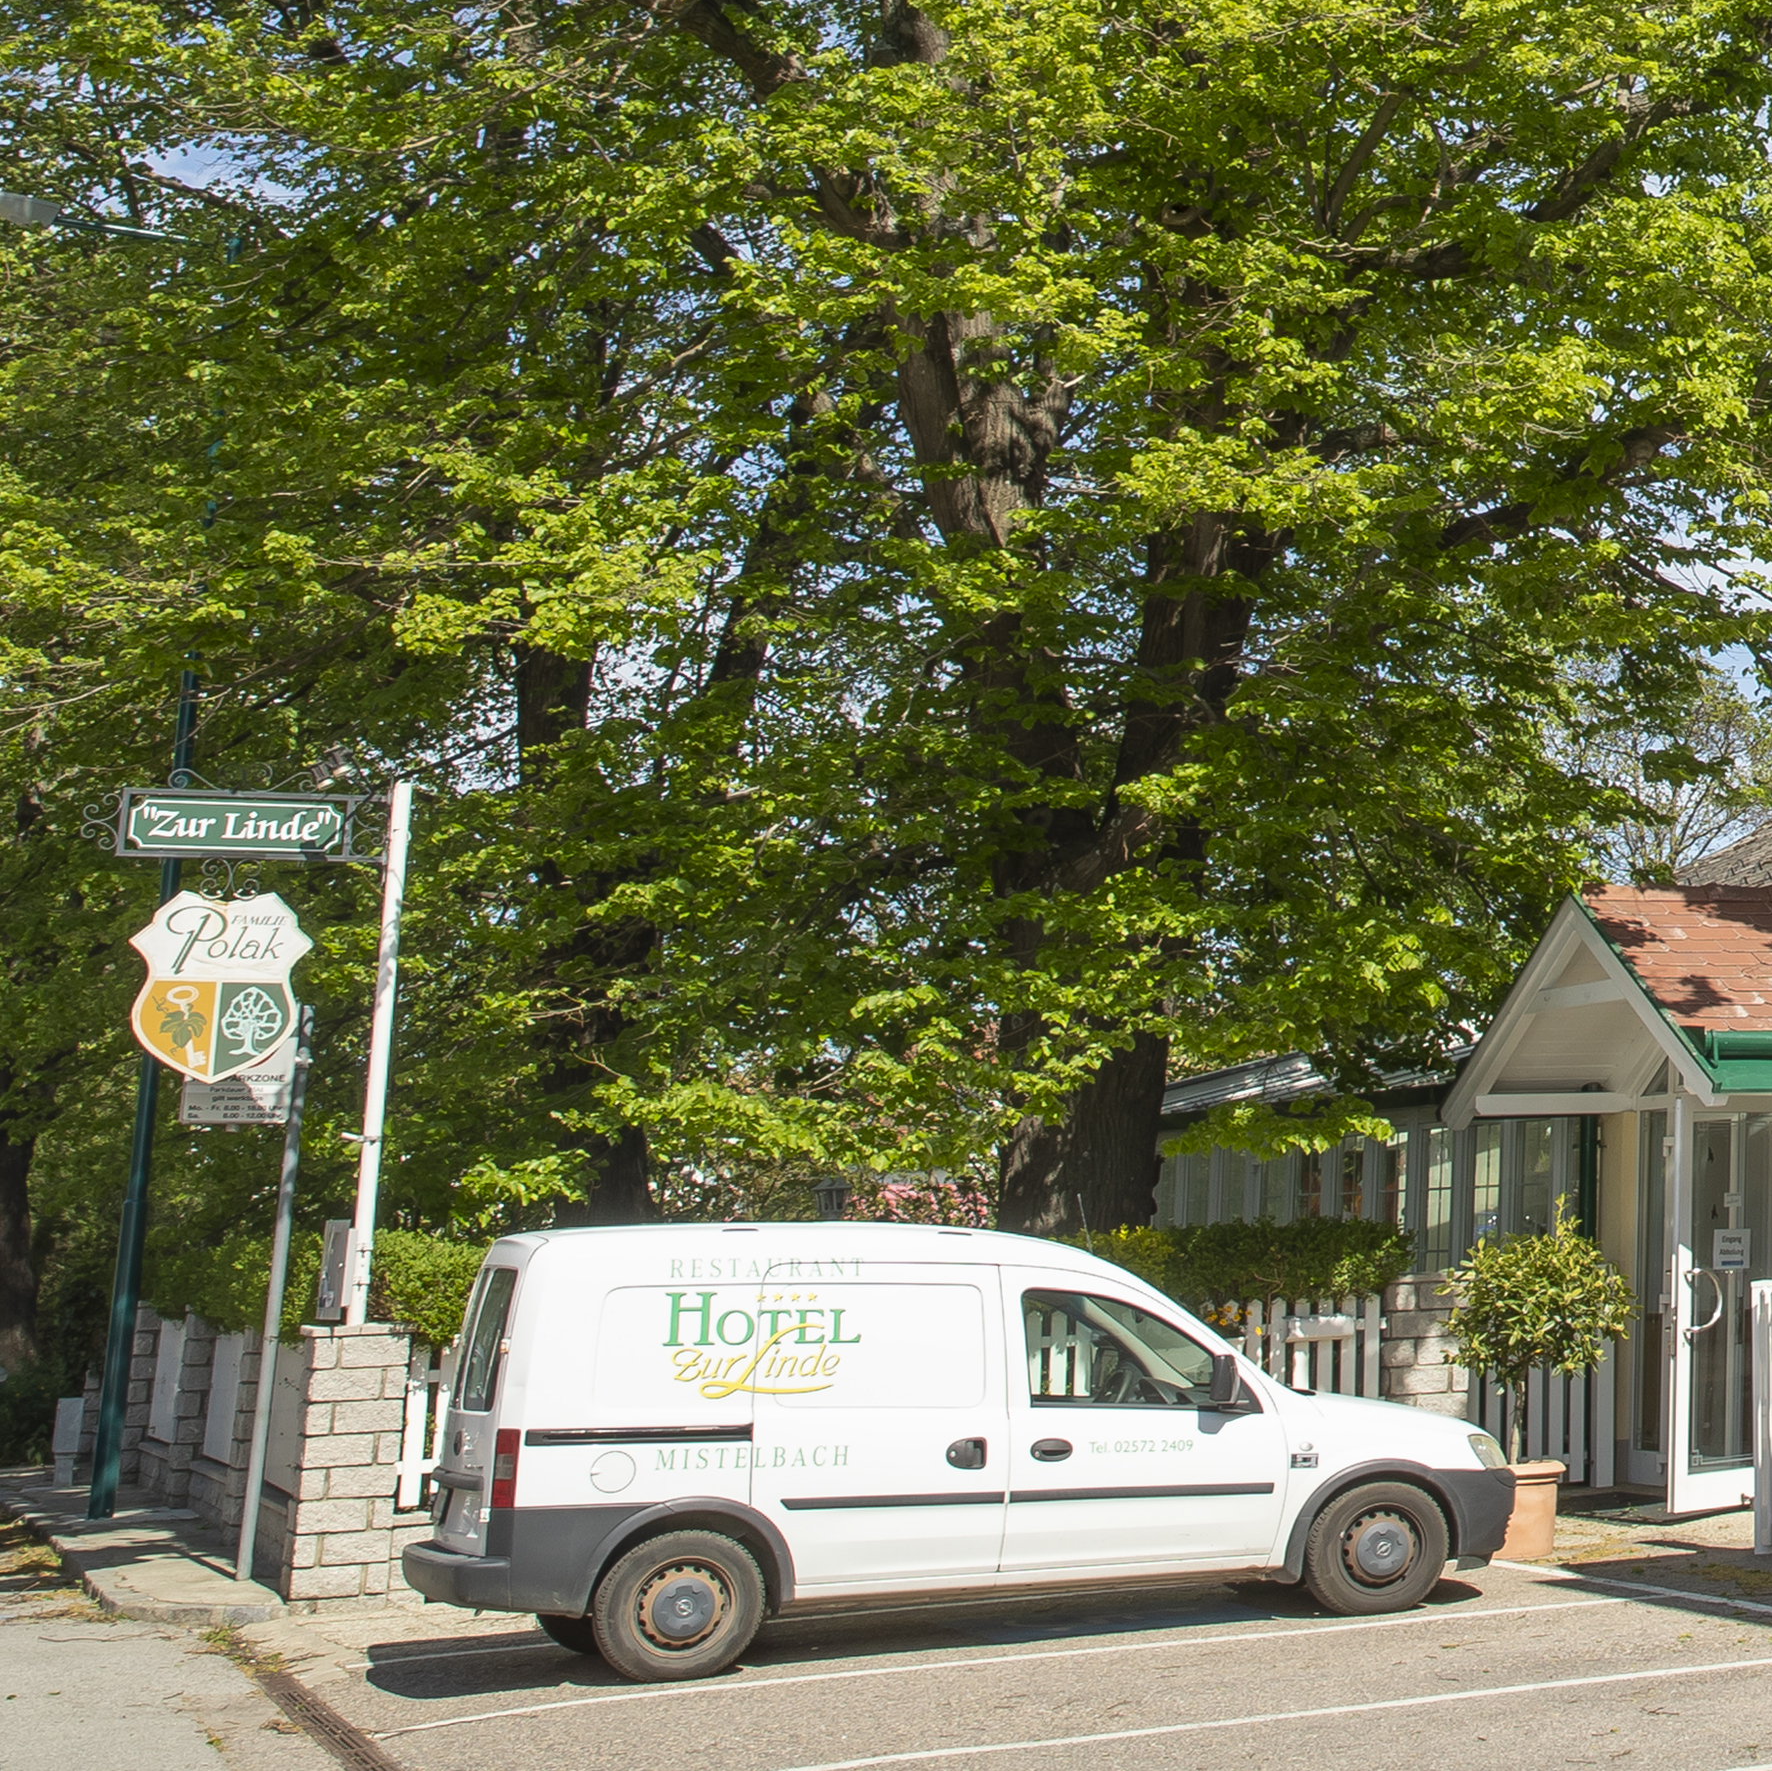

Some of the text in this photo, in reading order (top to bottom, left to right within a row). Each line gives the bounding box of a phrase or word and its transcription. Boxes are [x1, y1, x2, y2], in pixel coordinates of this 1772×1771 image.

[142, 806, 332, 841] "Zur Linde"
[231, 914, 288, 926] FAMILIE
[167, 906, 284, 975] Polak
[670, 1257, 864, 1278] RESTAURANT
[662, 1292, 862, 1346] HOTEL
[671, 1323, 841, 1399] Zur Linde
[655, 1445, 849, 1470] MISTELBACH
[1089, 1439, 1194, 1454] Tel. 02572 2409
